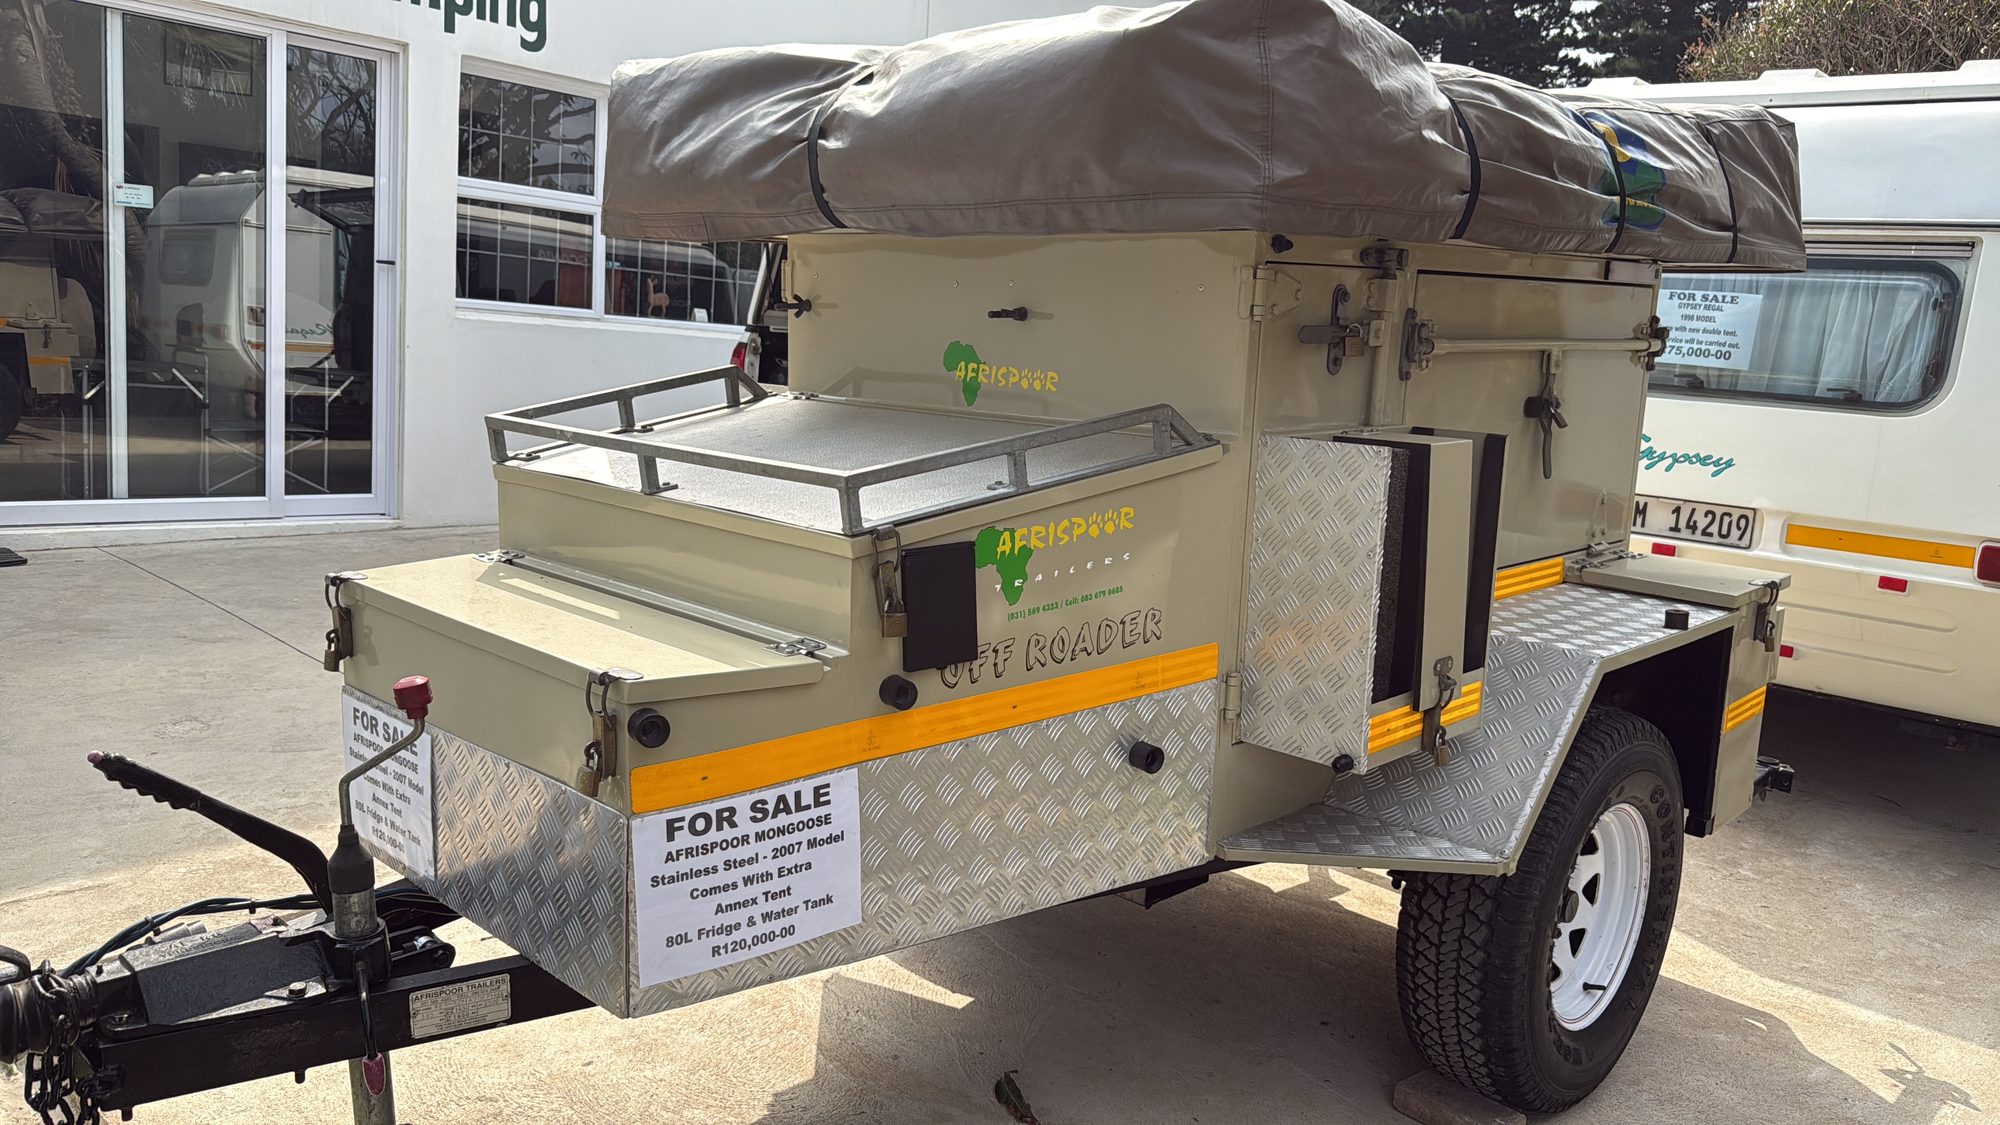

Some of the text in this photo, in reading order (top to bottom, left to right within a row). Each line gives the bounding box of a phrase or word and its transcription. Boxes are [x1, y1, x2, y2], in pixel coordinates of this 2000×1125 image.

[393, 0, 547, 52] png
[1668, 291, 1740, 305] FOR SALE
[1678, 302, 1724, 312] GYPSEY REGAL
[1696, 315, 1716, 323] MODEL
[1663, 345, 1732, 360] 75,000-00
[1704, 339, 1726, 348] carried
[1668, 506, 1750, 541] 14209
[994, 553, 1130, 592] TRAILERS
[1007, 611, 1026, 622] (031)
[1028, 606, 1040, 617] 569
[1042, 602, 1059, 612] 4323
[1065, 598, 1079, 607] Cell:
[1080, 595, 1093, 603] 083
[1094, 590, 1106, 599] 679
[940, 607, 1163, 689] OFF ROADER
[352, 706, 380, 738] FOR
[349, 746, 369, 762] Stainl
[375, 765, 388, 776] eel
[393, 769, 407, 785] 2007
[408, 777, 424, 796] Model
[389, 754, 418, 774] ONGOOSE
[372, 793, 402, 818] Annex Tent
[382, 780, 394, 796] With
[396, 789, 411, 805] Extra
[367, 806, 383, 824] Fridge
[390, 819, 406, 837] Water
[407, 830, 422, 847] Tank
[666, 783, 831, 842] FOR SALE
[664, 813, 832, 864] AFRISPOOR MONGOOSE
[650, 865, 719, 888] Stainless
[723, 852, 759, 872] Steel
[771, 842, 802, 860] 2007
[807, 831, 845, 850] Model
[689, 861, 813, 900] Comes With Extra
[714, 885, 792, 916] Annex Tent
[665, 893, 834, 948] 80L Fridge & Water Tank
[711, 924, 796, 958] R120,000-00
[414, 986, 464, 1002] AFRISPOOR
[466, 977, 506, 990] TRAILERS
